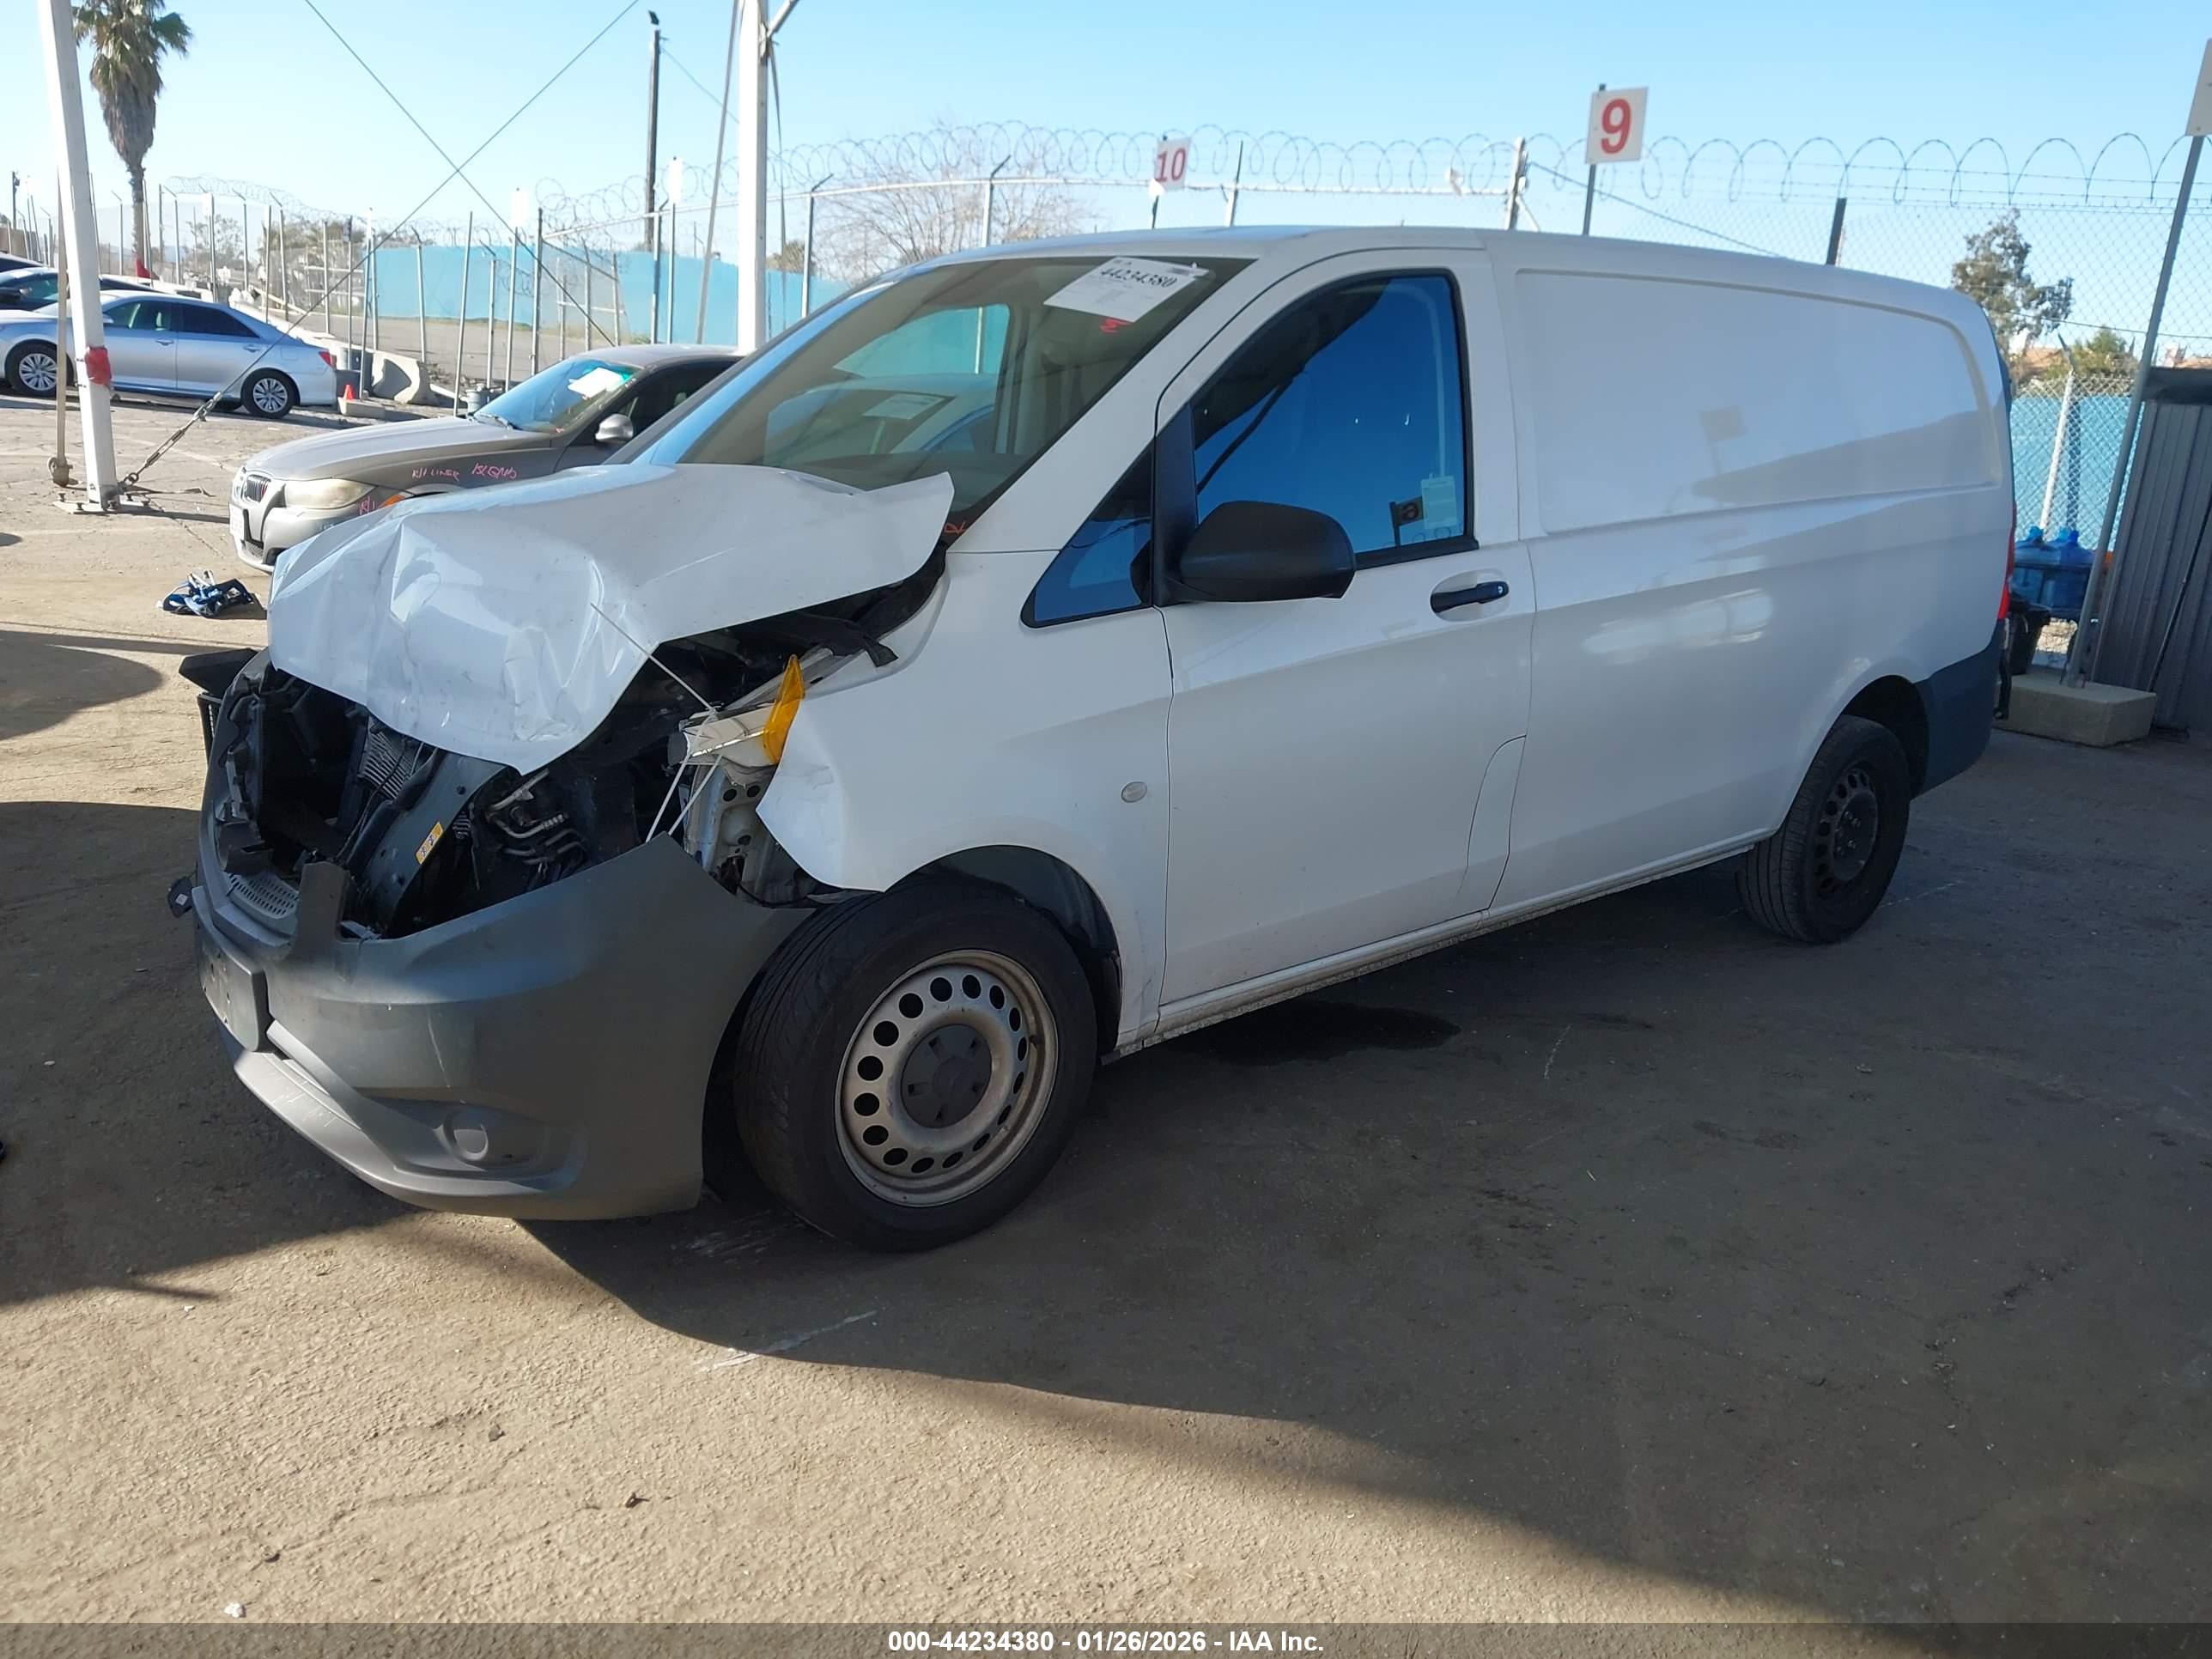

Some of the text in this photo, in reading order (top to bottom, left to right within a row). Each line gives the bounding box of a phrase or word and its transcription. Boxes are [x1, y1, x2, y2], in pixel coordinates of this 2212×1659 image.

[1601, 98, 1631, 155] 9
[1156, 148, 1186, 183] 10
[1100, 268, 1178, 289] 44234380
